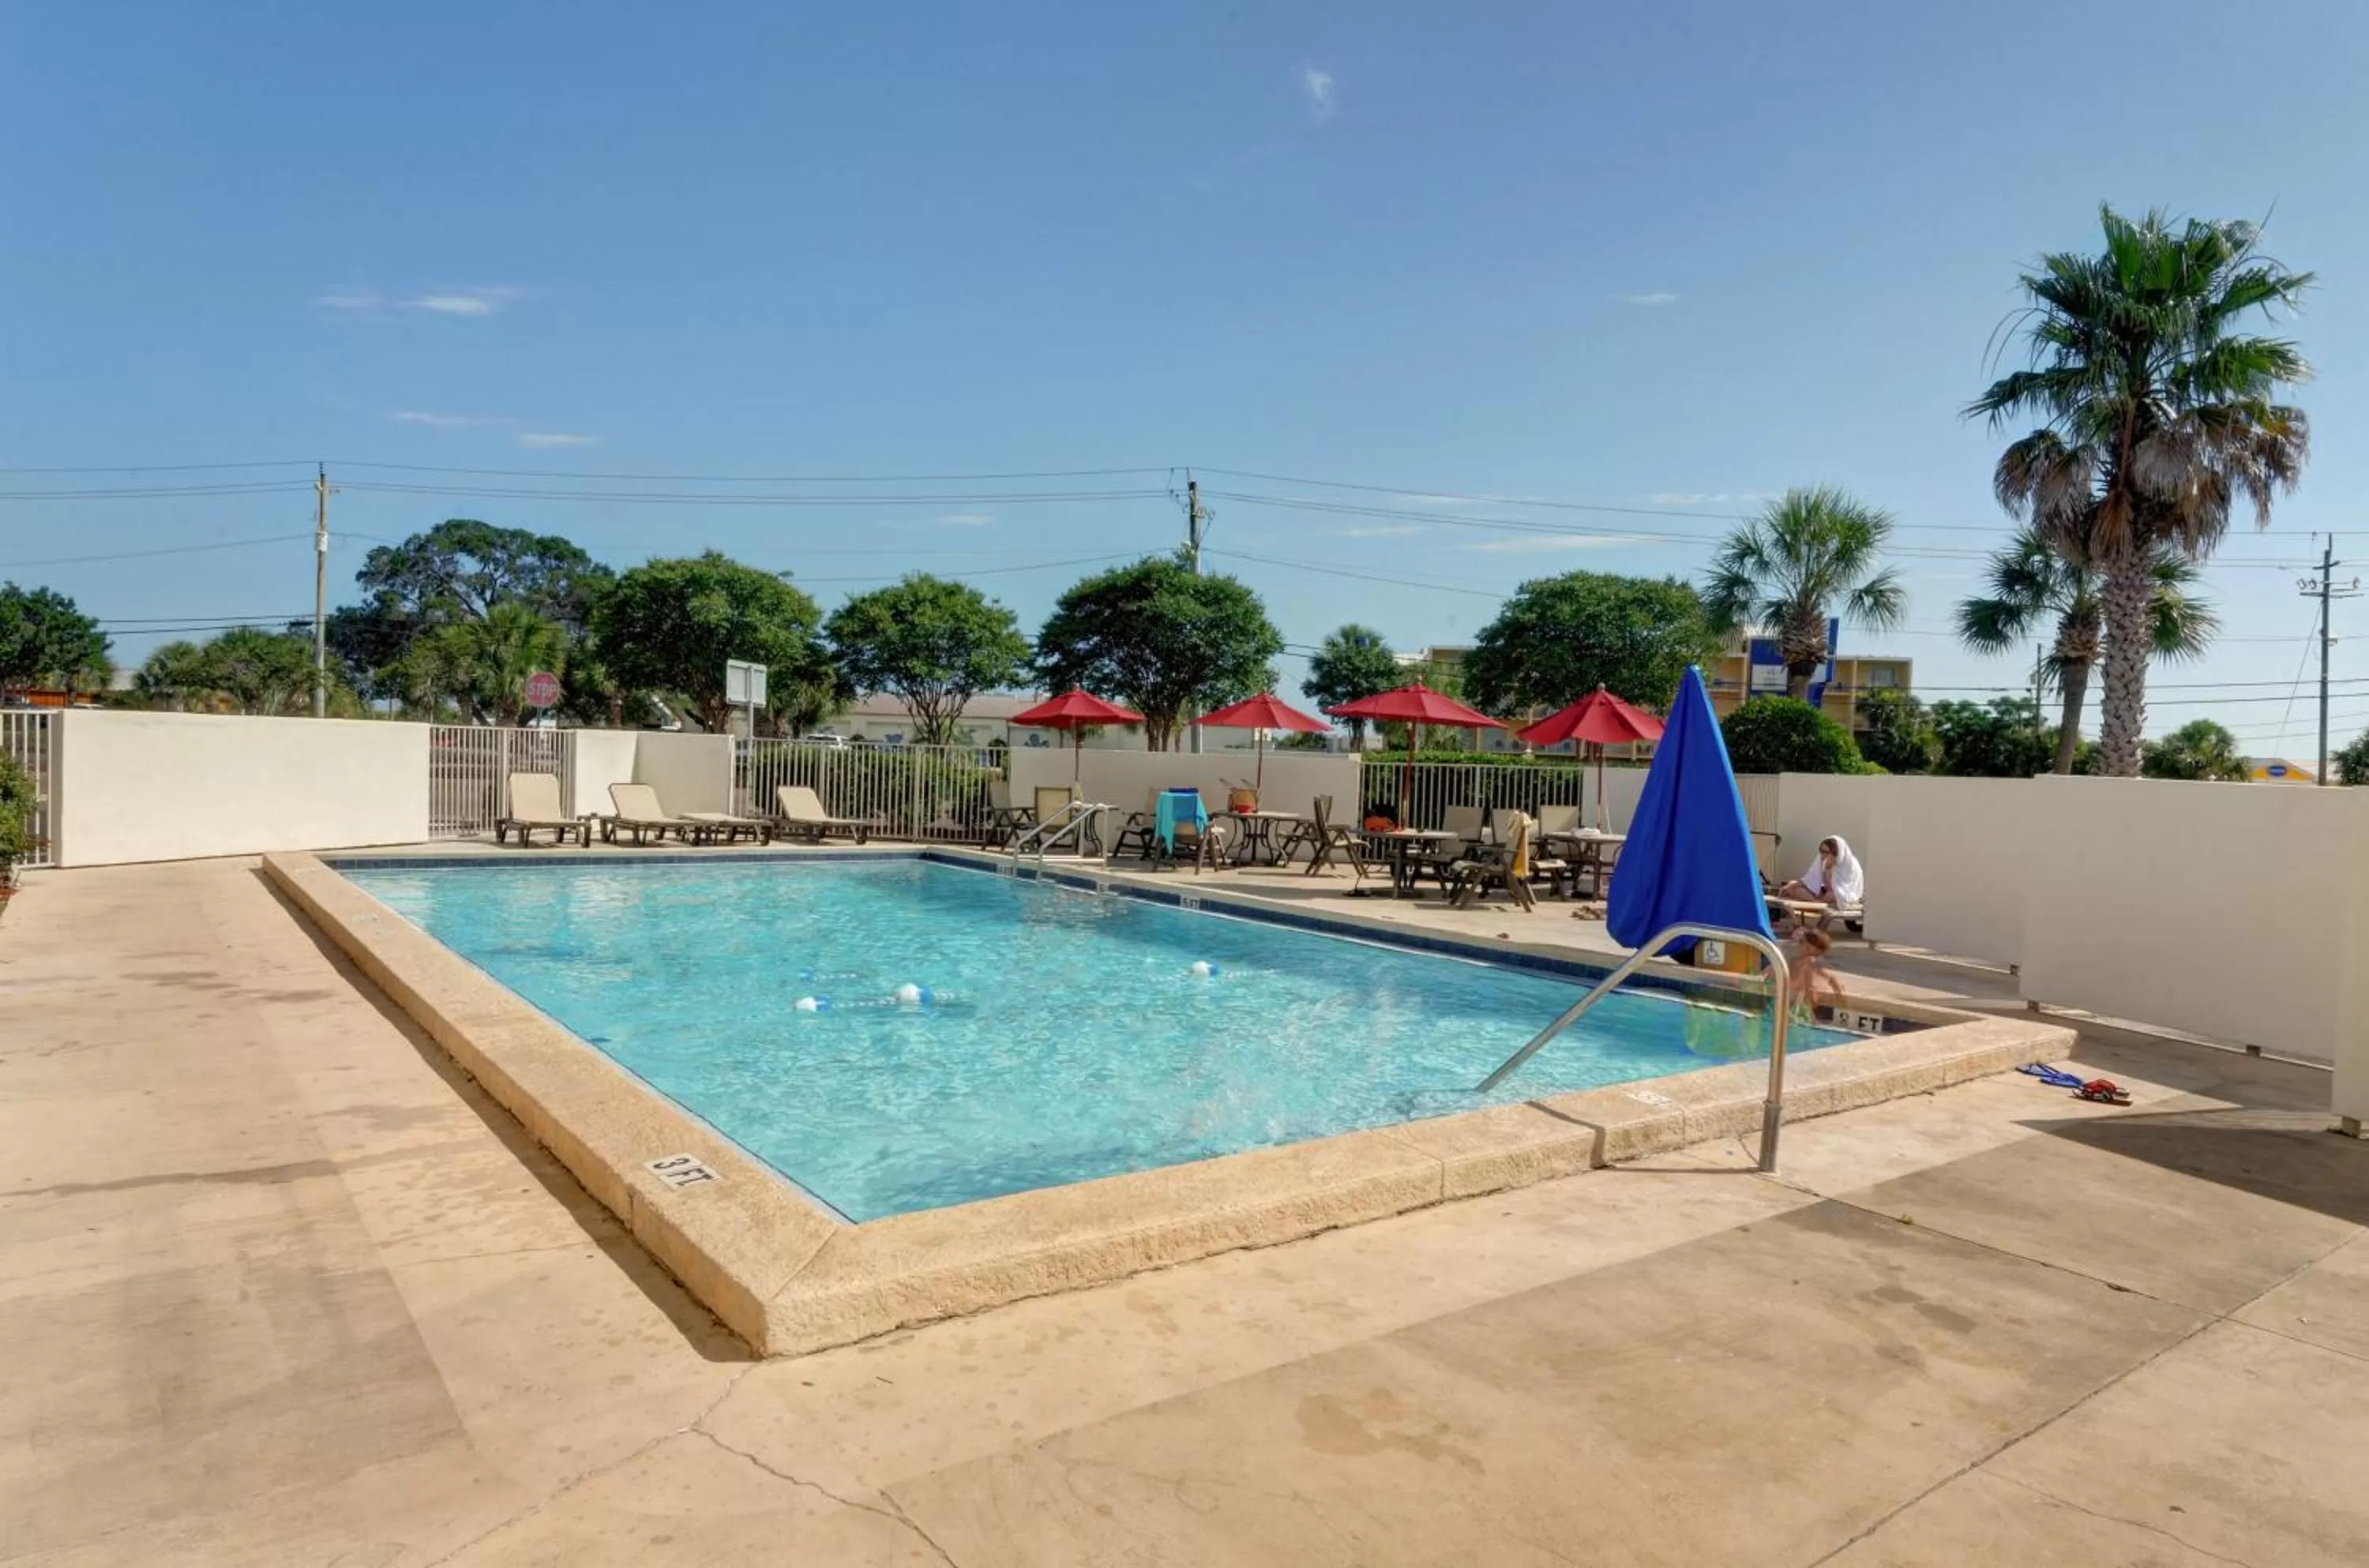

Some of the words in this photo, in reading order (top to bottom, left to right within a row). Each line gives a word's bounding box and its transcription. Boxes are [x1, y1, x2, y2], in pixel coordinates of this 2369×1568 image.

[528, 682, 557, 696] STOP
[653, 1157, 690, 1168] 3
[666, 1168, 714, 1187] FT
